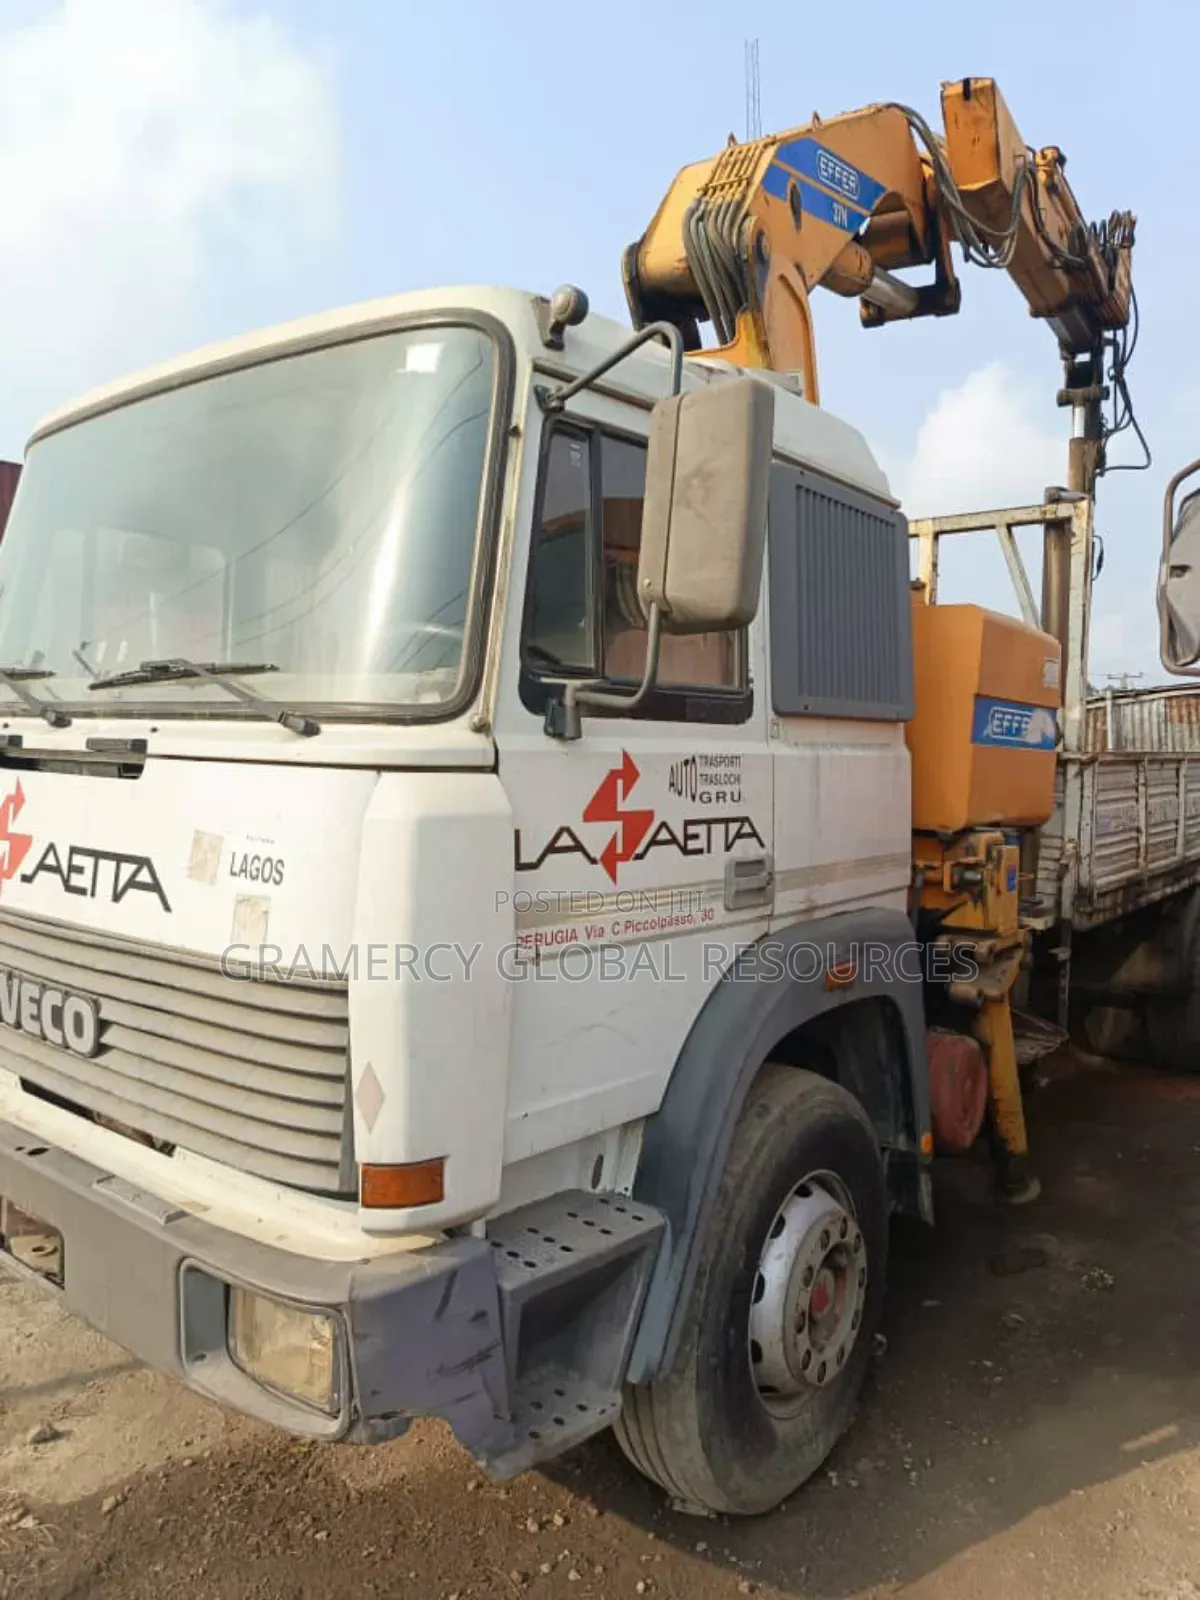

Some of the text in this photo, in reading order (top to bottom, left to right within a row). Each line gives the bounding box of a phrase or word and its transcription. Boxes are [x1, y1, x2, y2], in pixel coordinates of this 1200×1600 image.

[819, 155, 858, 196] EFFER
[991, 711, 1031, 735] EFFE
[668, 754, 697, 803] AUTO
[699, 754, 741, 769] TRASPORTI
[699, 788, 742, 804] GRU
[229, 850, 285, 886] LAGOS
[516, 927, 578, 950] PERUGIA
[585, 925, 605, 941] Via
[701, 906, 716, 923] 30
